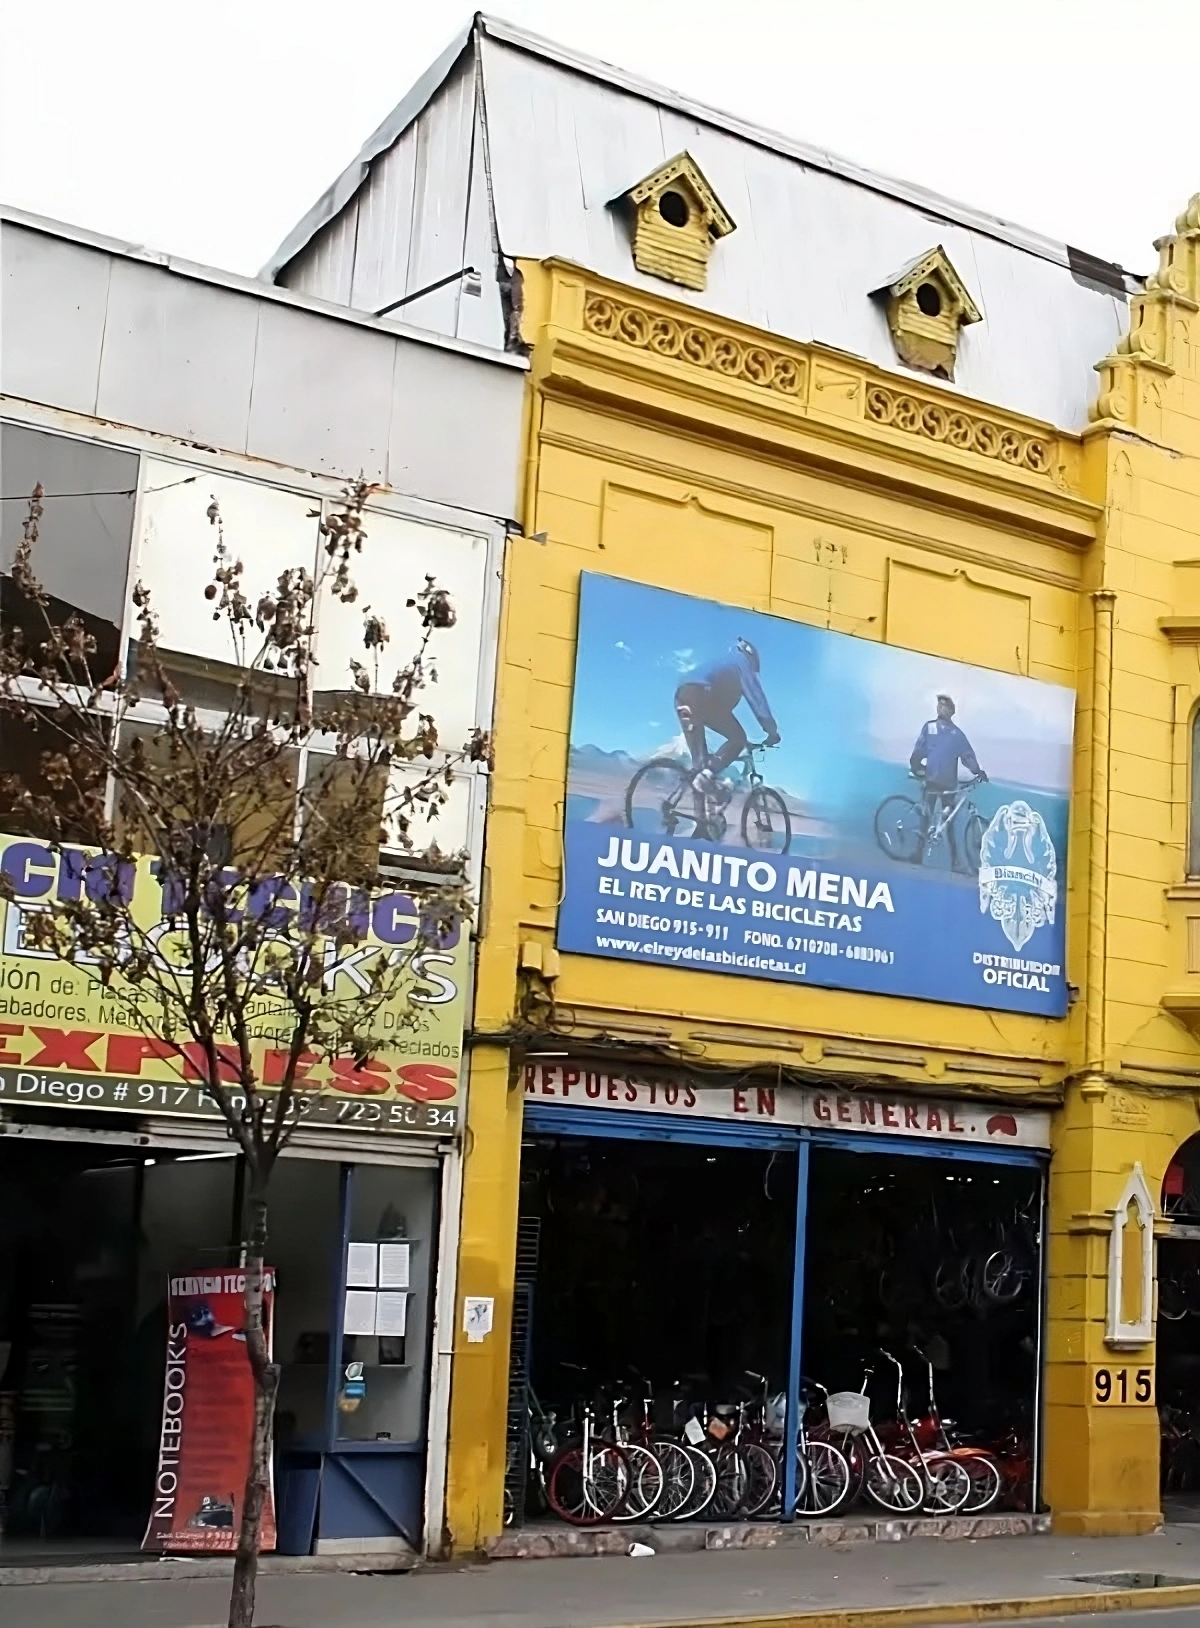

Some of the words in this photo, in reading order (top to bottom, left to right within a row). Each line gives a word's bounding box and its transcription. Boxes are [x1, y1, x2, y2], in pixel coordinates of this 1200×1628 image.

[597, 836, 777, 893] JUANITO
[786, 867, 895, 913] MENA
[596, 908, 625, 926] SAN
[628, 912, 671, 932] DIEGO
[598, 876, 625, 897] EL
[629, 881, 672, 903] REY
[675, 888, 705, 908] DE
[709, 894, 747, 915] LAS
[752, 900, 862, 933] BICICLETAS
[983, 967, 1051, 993] OFICIAL
[16, 1073, 105, 1102] Diego
[113, 1082, 129, 1101] #
[137, 1083, 190, 1106] 917
[426, 1108, 457, 1127] 34
[524, 1063, 697, 1108] REPUESTOS
[733, 1087, 776, 1116] EN
[1095, 1369, 1152, 1403] 915
[153, 1322, 188, 1518] NOTEBOOK'S
